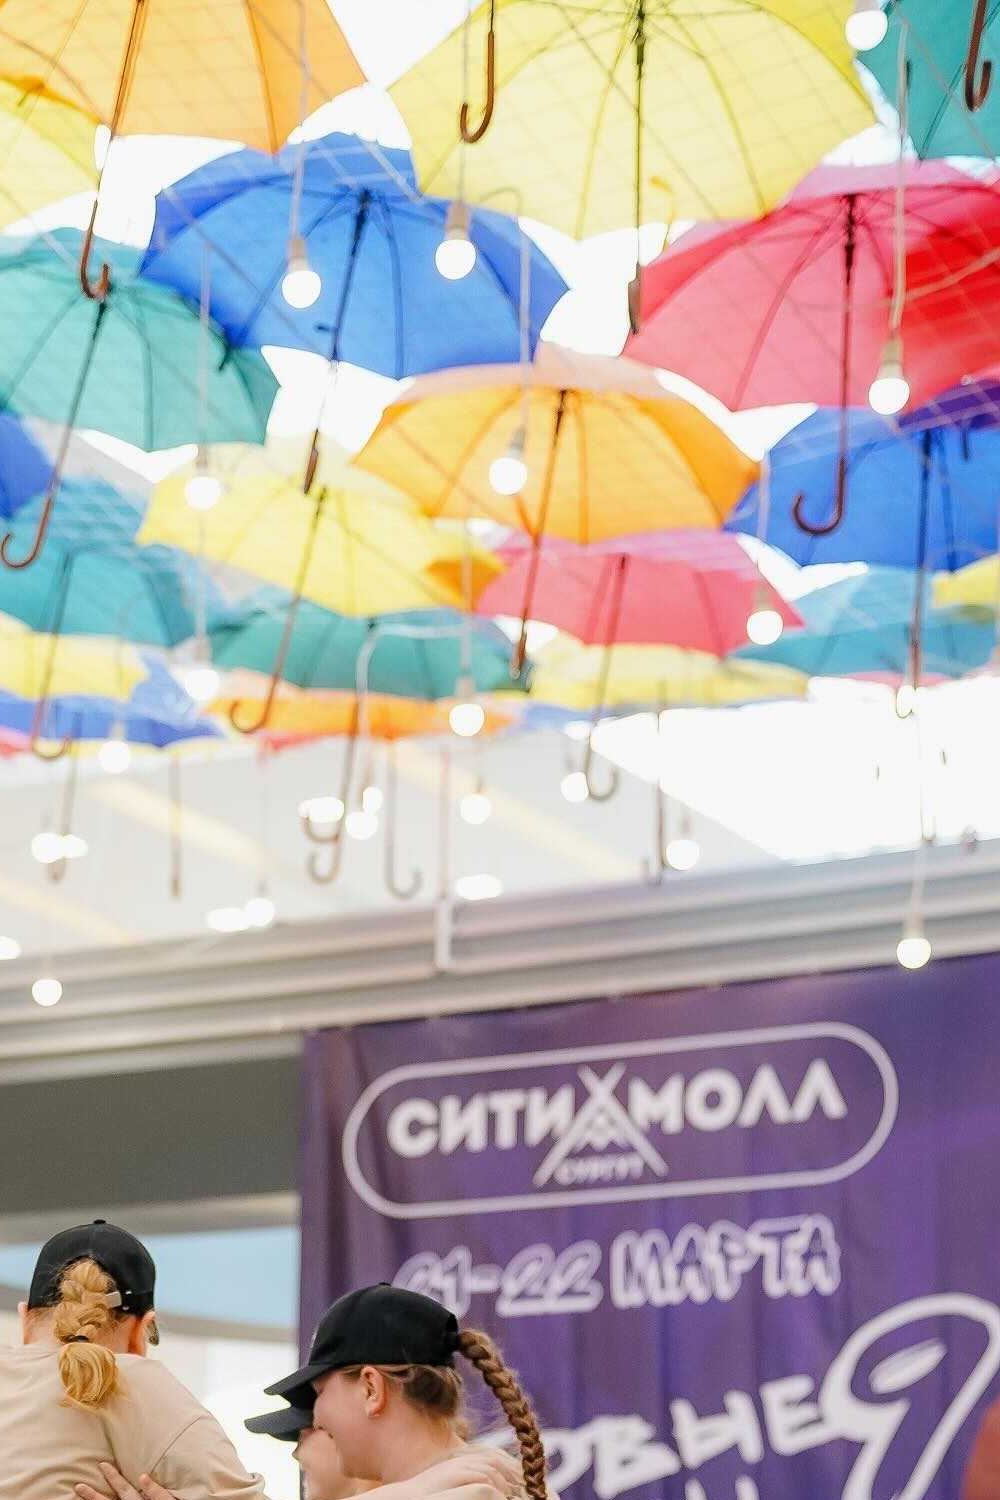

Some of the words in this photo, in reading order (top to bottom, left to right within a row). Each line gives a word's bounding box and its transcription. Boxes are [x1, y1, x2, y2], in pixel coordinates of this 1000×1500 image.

[387, 1085, 576, 1158] СИТИ
[629, 1058, 849, 1135] МОЛЛ
[610, 1213, 841, 1308] МАРТА
[470, 1372, 832, 1500] ОВЫЕ
